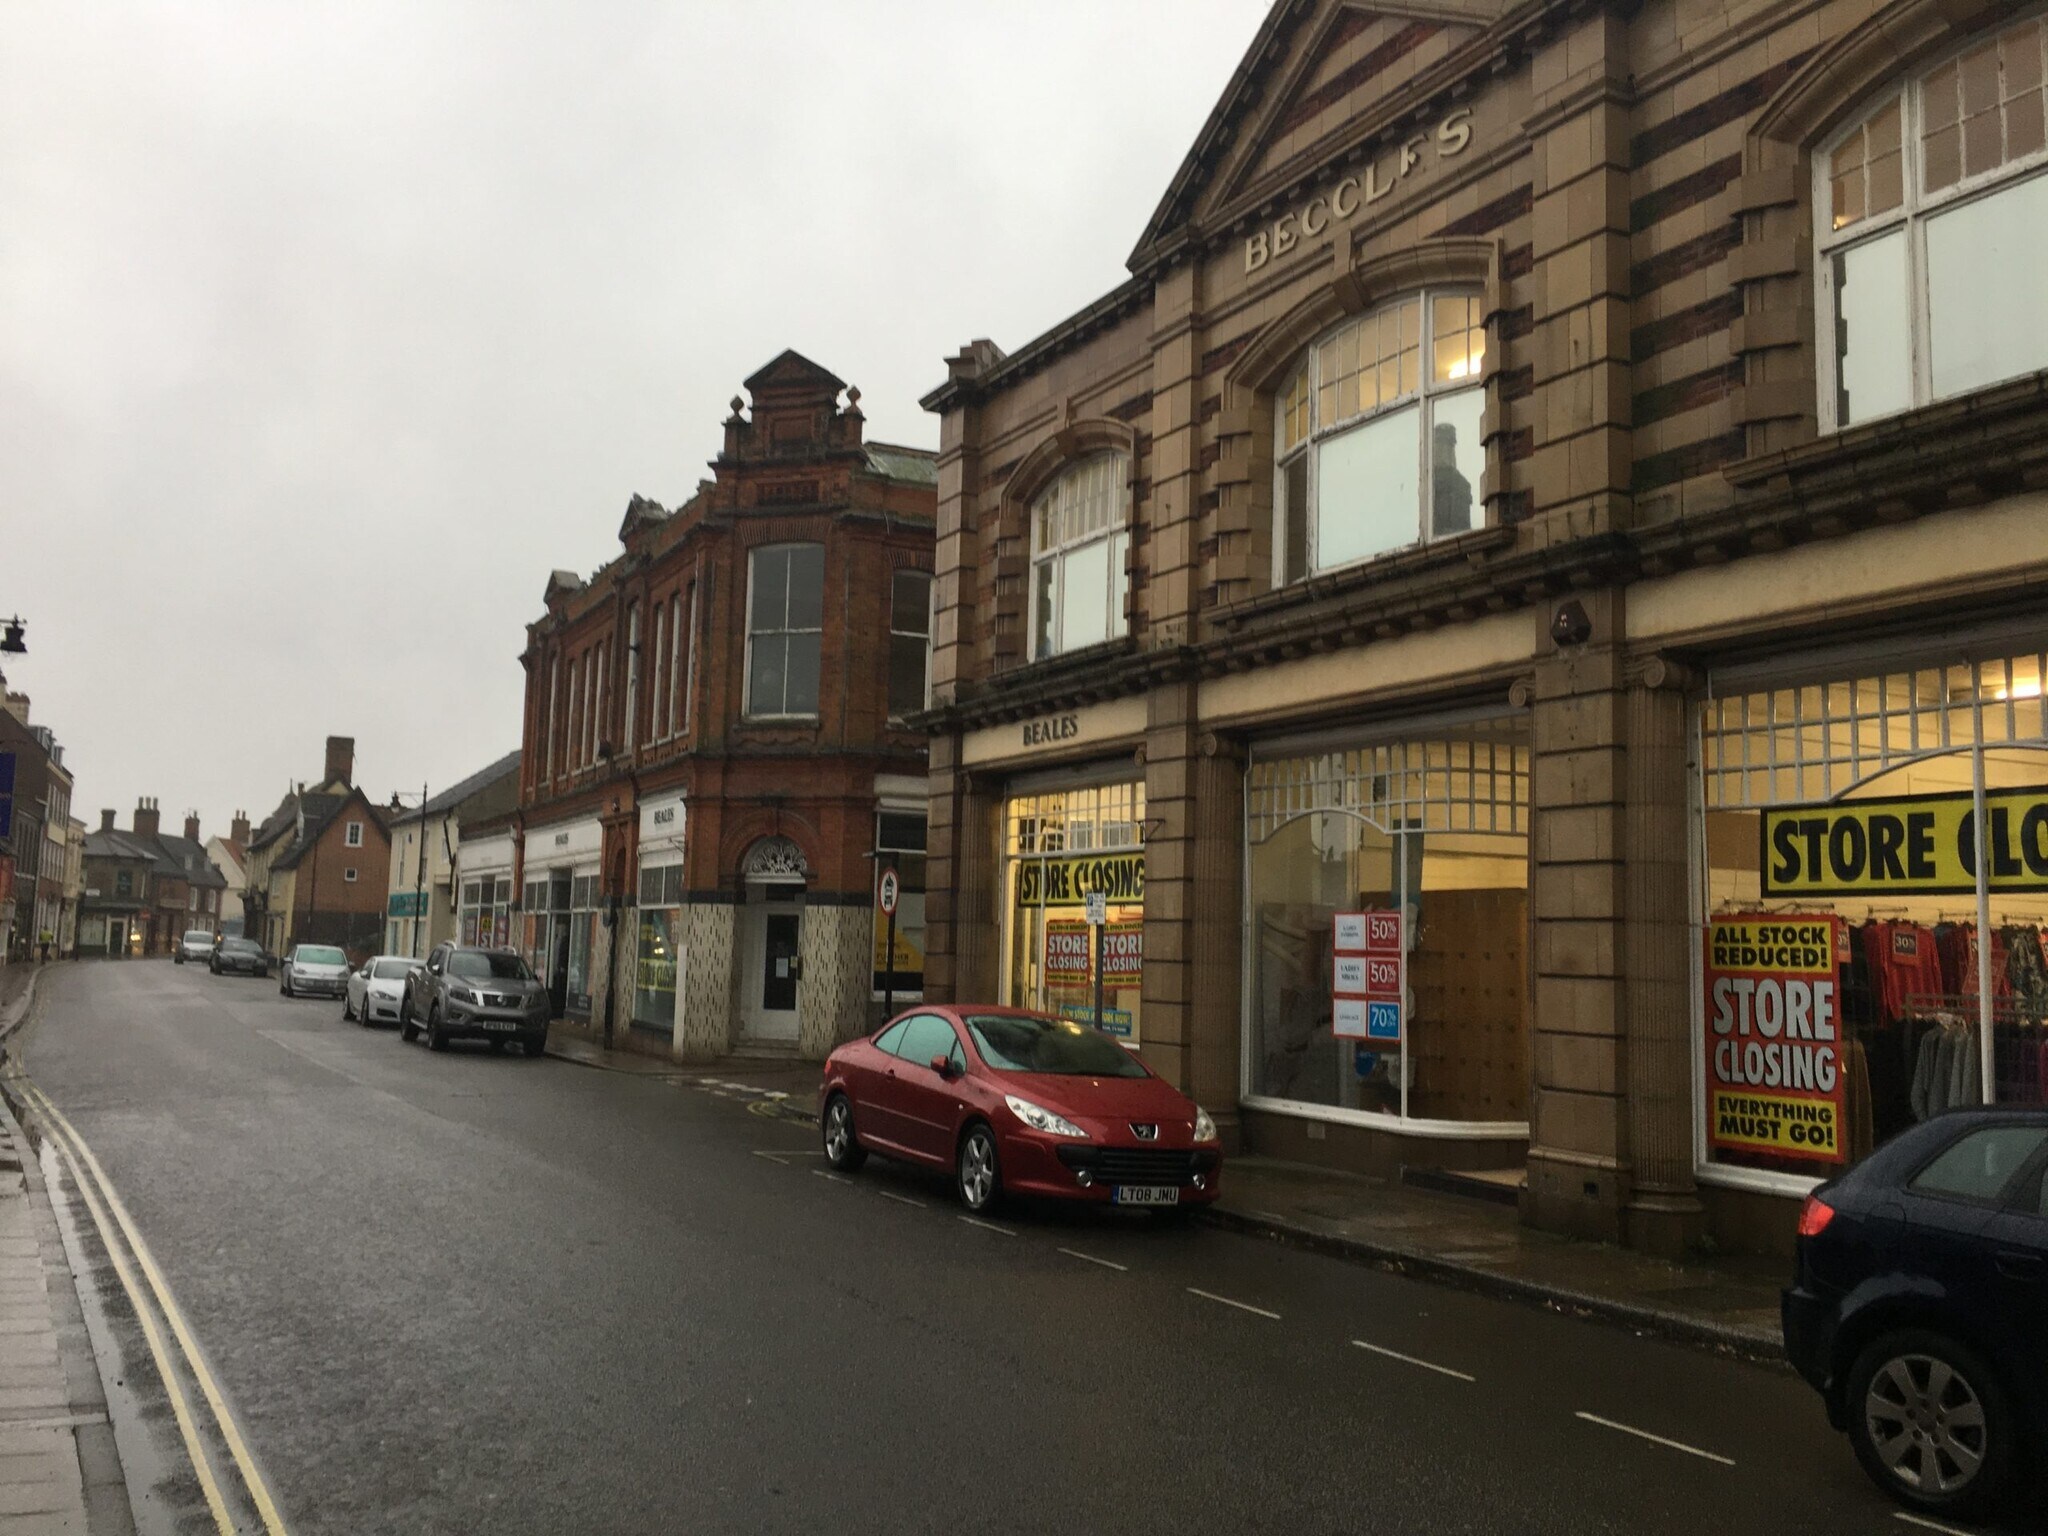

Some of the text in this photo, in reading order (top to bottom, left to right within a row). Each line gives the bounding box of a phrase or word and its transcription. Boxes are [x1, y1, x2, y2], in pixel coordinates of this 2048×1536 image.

[1023, 714, 1078, 747] BEALES
[1773, 812, 1936, 883] STORE
[1022, 858, 1145, 901] STORE CLOSING
[1371, 920, 1397, 939] 50%
[1714, 926, 1827, 945] ALL STOCK
[1049, 935, 1088, 954] STORE
[1714, 946, 1828, 968] REDUCED!
[1048, 956, 1088, 970] CLOSING
[1371, 964, 1397, 983] 50%
[1371, 1006, 1397, 1027] 70%
[1713, 976, 1835, 1041] STORE
[1714, 1038, 1837, 1093] CLOSING
[1718, 1095, 1833, 1123] EVERYTHING
[1719, 1115, 1834, 1147] MUST GO!
